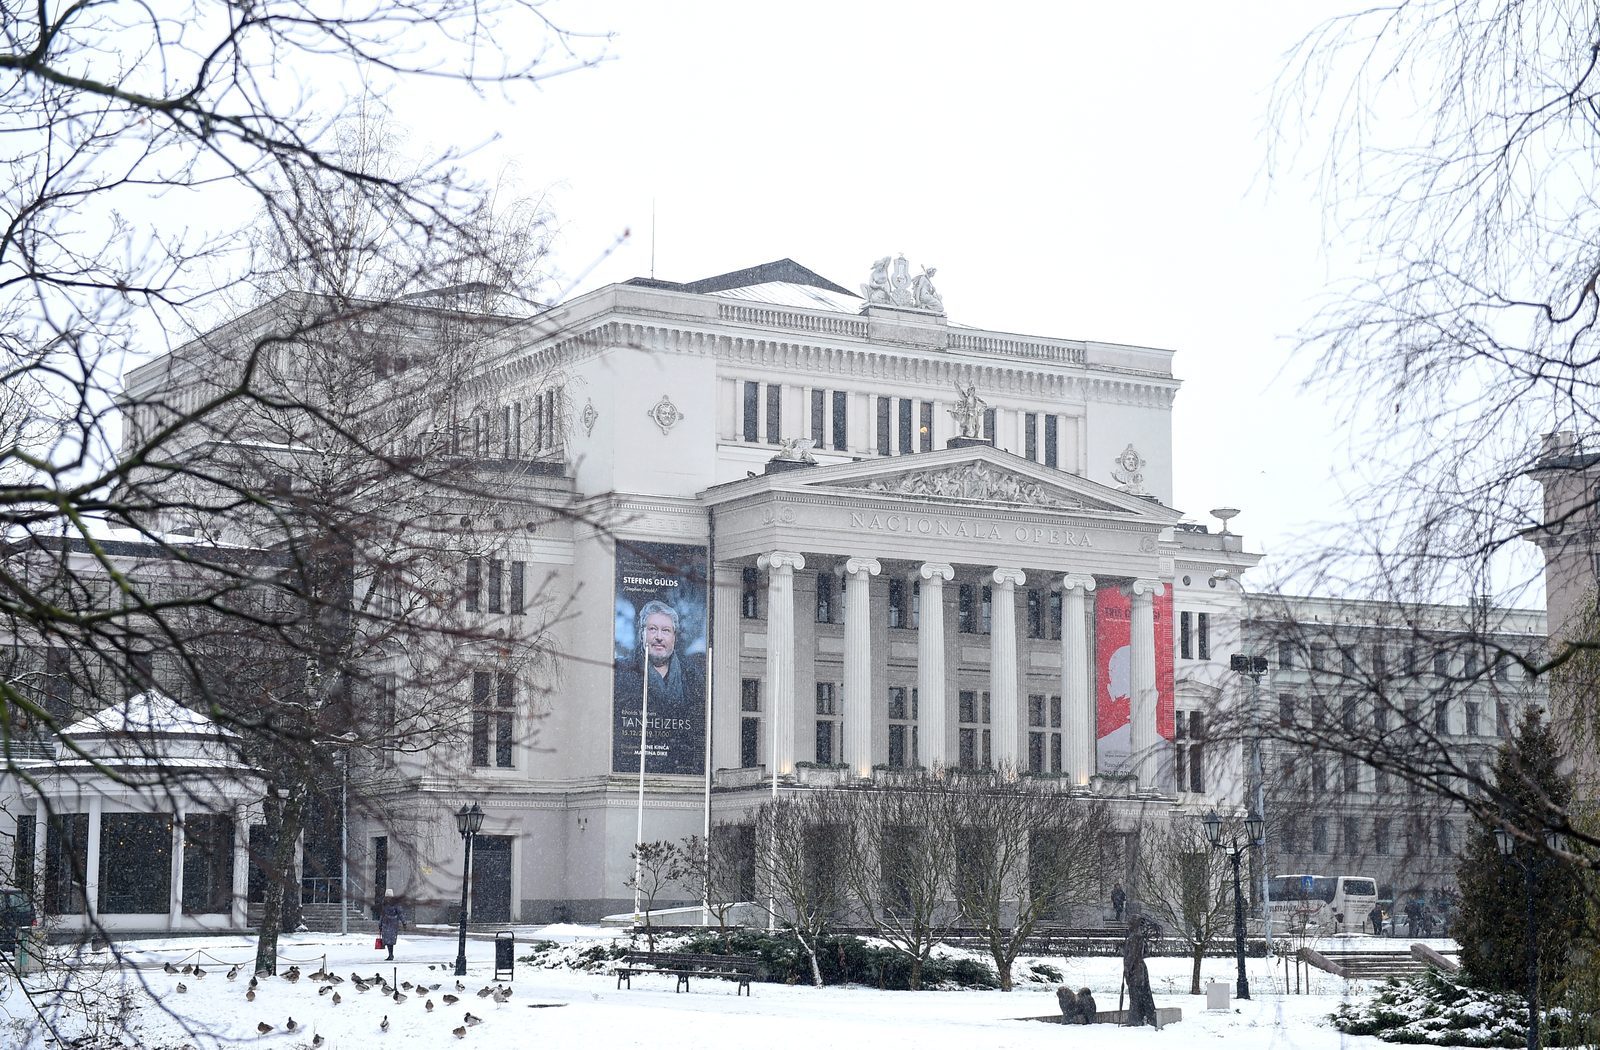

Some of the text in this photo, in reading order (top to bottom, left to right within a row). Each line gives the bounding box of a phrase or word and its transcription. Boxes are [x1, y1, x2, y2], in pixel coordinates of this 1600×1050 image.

[850, 512, 1093, 547] NACIONĀLĀ OPERA
[623, 577, 679, 587] STEFENS GŪLDS
[621, 717, 691, 730] TANHEIZERS
